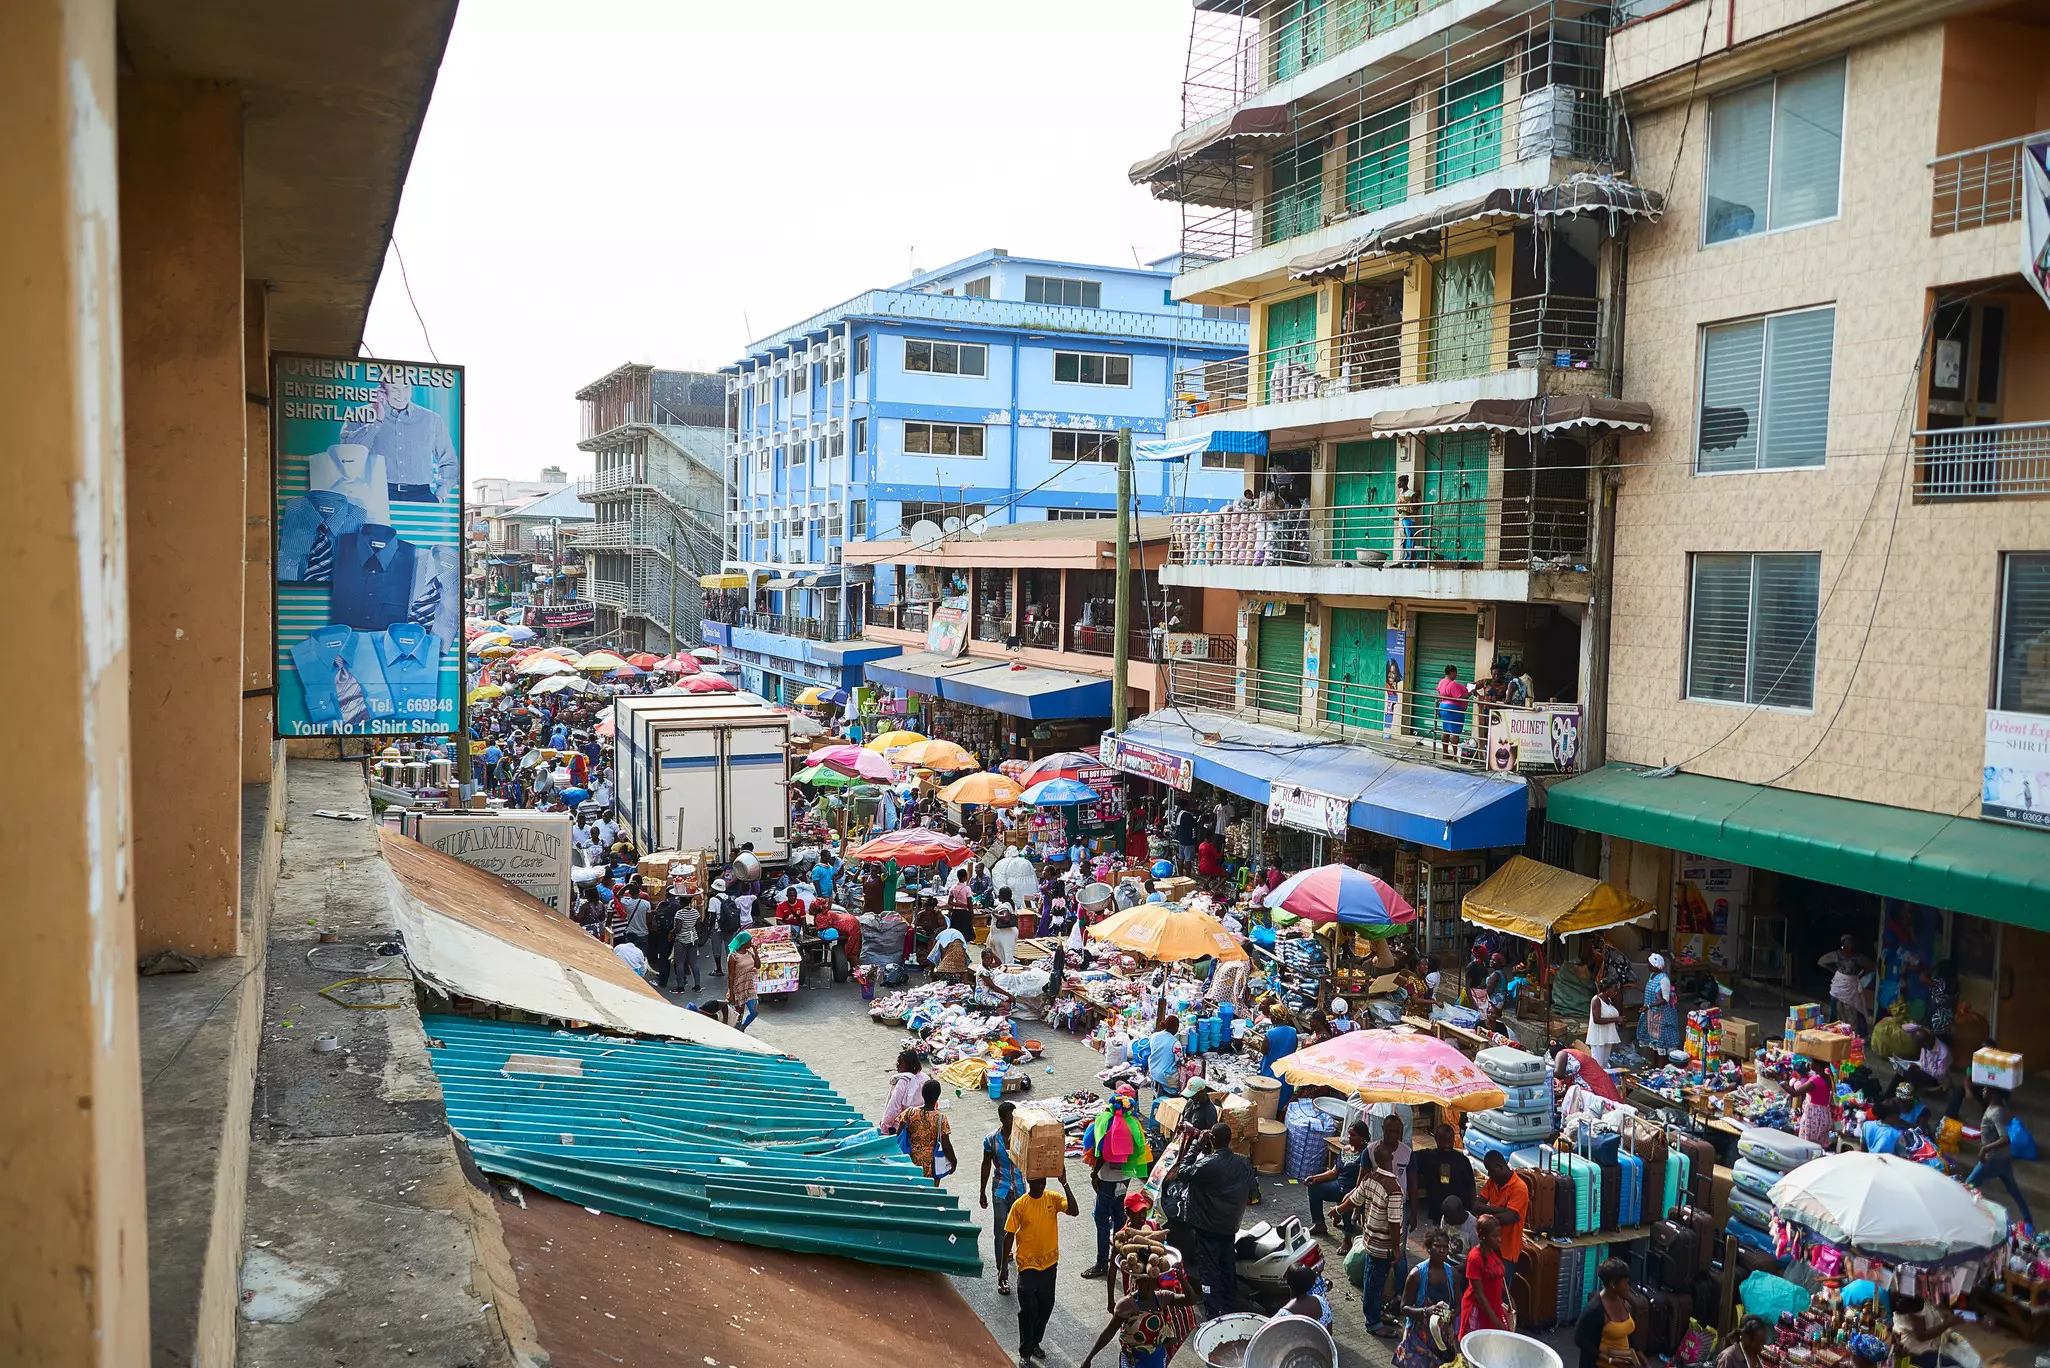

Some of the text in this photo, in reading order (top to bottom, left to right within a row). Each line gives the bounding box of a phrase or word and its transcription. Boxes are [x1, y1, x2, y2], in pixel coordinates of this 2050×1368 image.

[285, 357, 456, 388] ORIENT EXPRESS
[285, 381, 378, 403] ENTERPRISE
[285, 402, 377, 424] SHIRTLAND
[370, 698, 394, 713] Tel.
[406, 698, 453, 713] 669848
[292, 719, 449, 735] Your No 1 Shirt Shop
[1510, 719, 1546, 735] ROLINET
[1989, 718, 2027, 736] Orient
[1079, 771, 1089, 779] THE
[1089, 770, 1099, 778] BOY
[1100, 769, 1121, 777] FASHION
[2005, 808, 2017, 818] Tel
[2022, 812, 2050, 825] 0302-6
[461, 855, 545, 872] eauty Care
[527, 871, 556, 879] GENUINE
